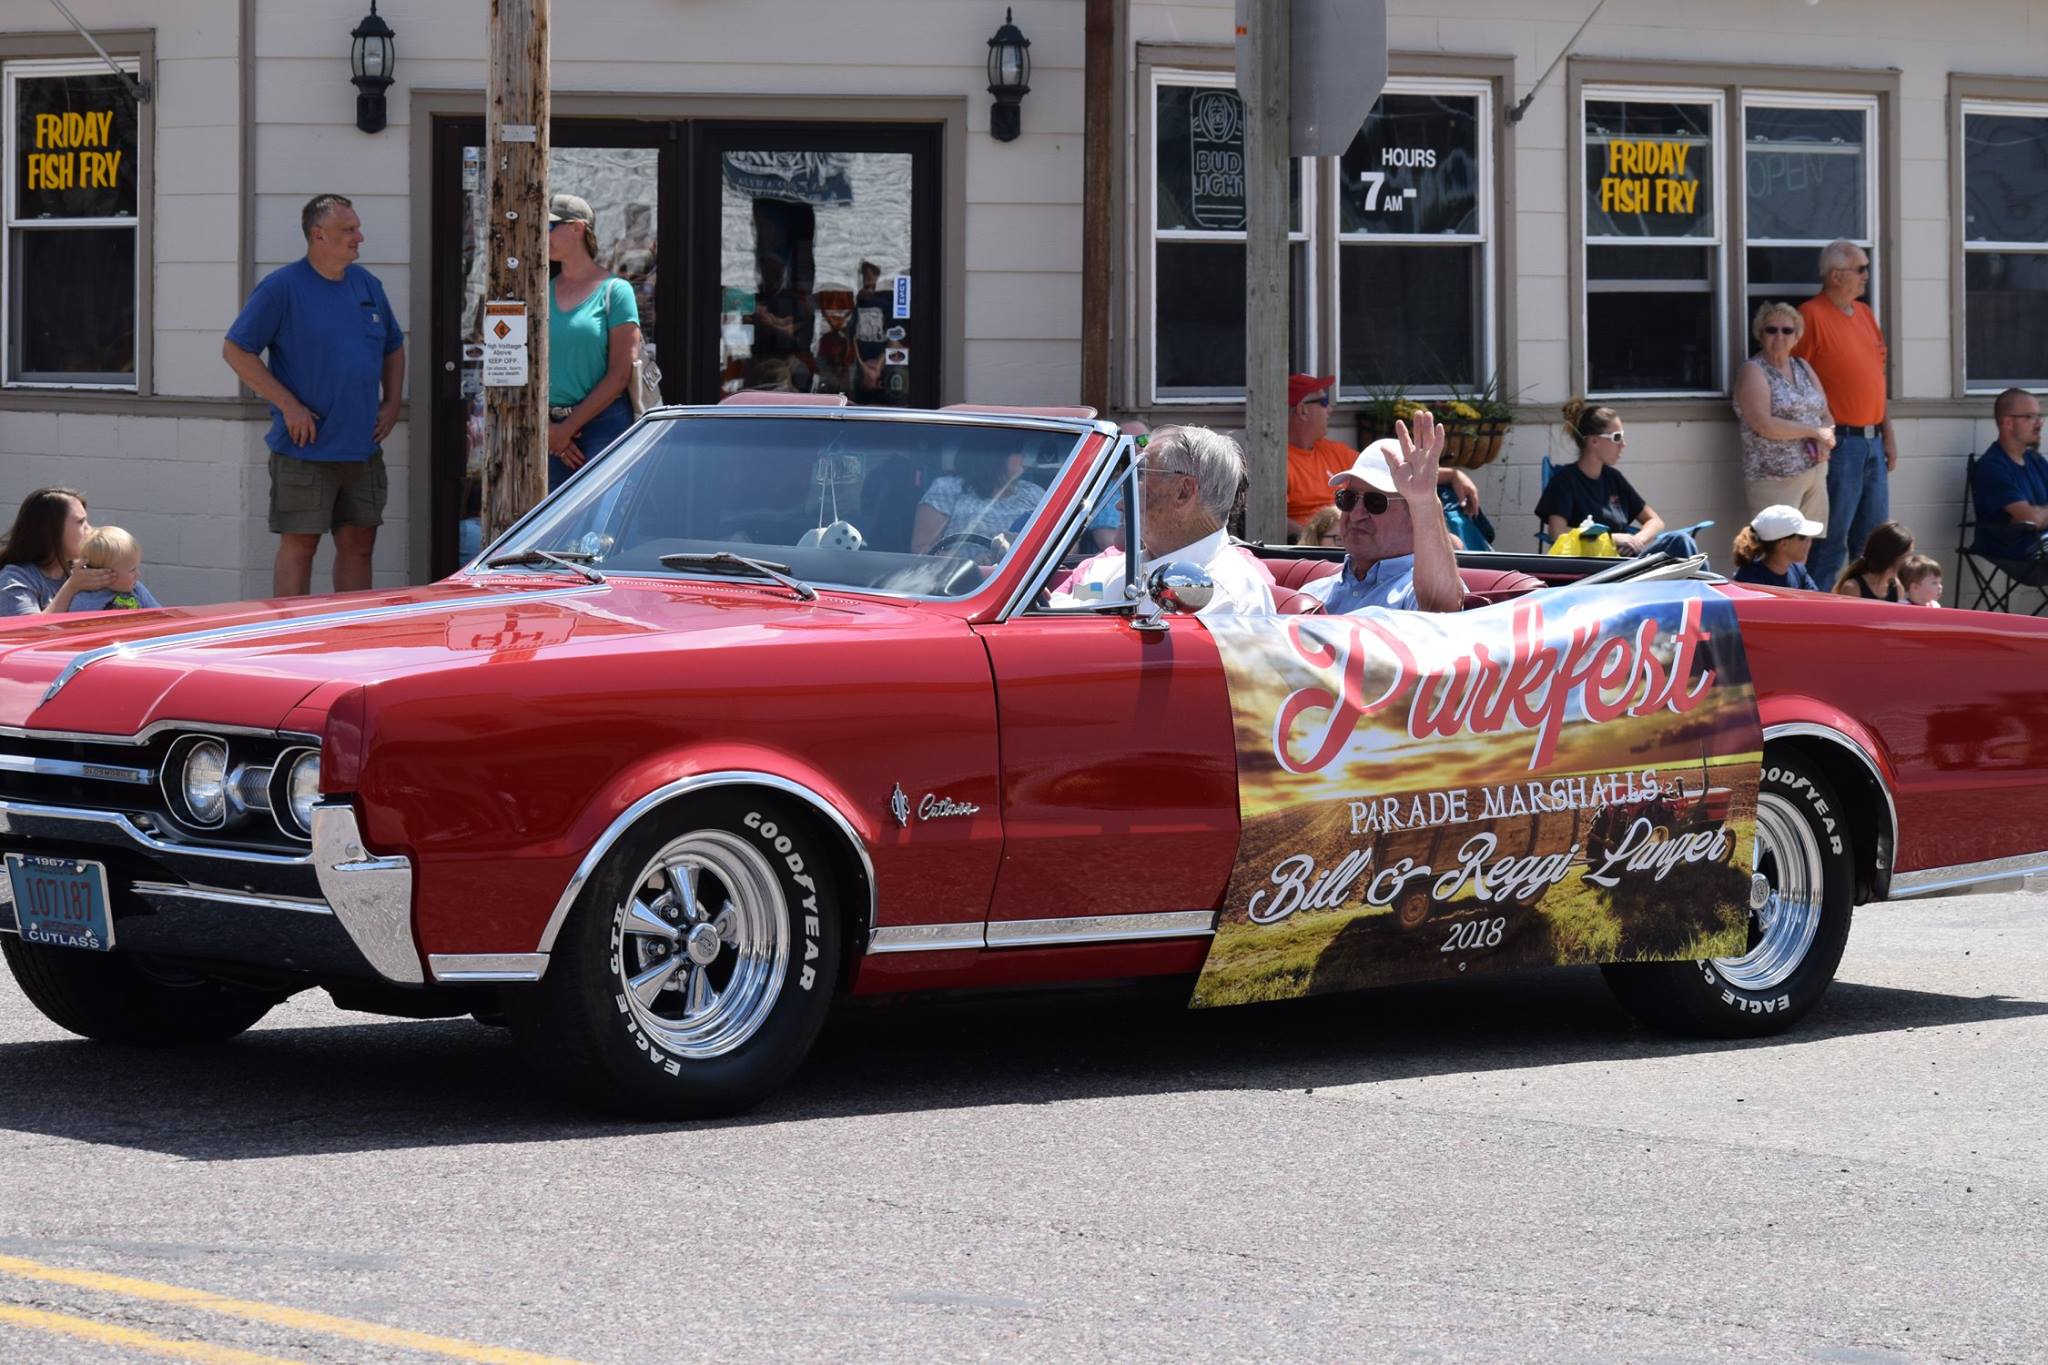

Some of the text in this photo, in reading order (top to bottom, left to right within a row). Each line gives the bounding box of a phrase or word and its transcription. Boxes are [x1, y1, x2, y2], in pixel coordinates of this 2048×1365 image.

[36, 110, 114, 149] FRIDAY
[28, 150, 122, 190] FISH FRY
[1196, 150, 1242, 174] BUD
[1382, 147, 1436, 168] HOURS
[1608, 139, 1690, 176] FRIDAY
[1748, 153, 1826, 198] OPEN
[1601, 178, 1699, 214] FISH FRY
[918, 793, 980, 821] Cutlass
[1349, 768, 1659, 835] PARADE MARSHALLS
[1249, 817, 1728, 925] Bill & Reggi Langer
[744, 811, 820, 991] GOODYEAR
[28, 930, 100, 949] CUTLASS
[1440, 917, 1506, 952] 2018
[1721, 988, 1791, 1014] EAGLE
[615, 993, 681, 1077] EAGLE
